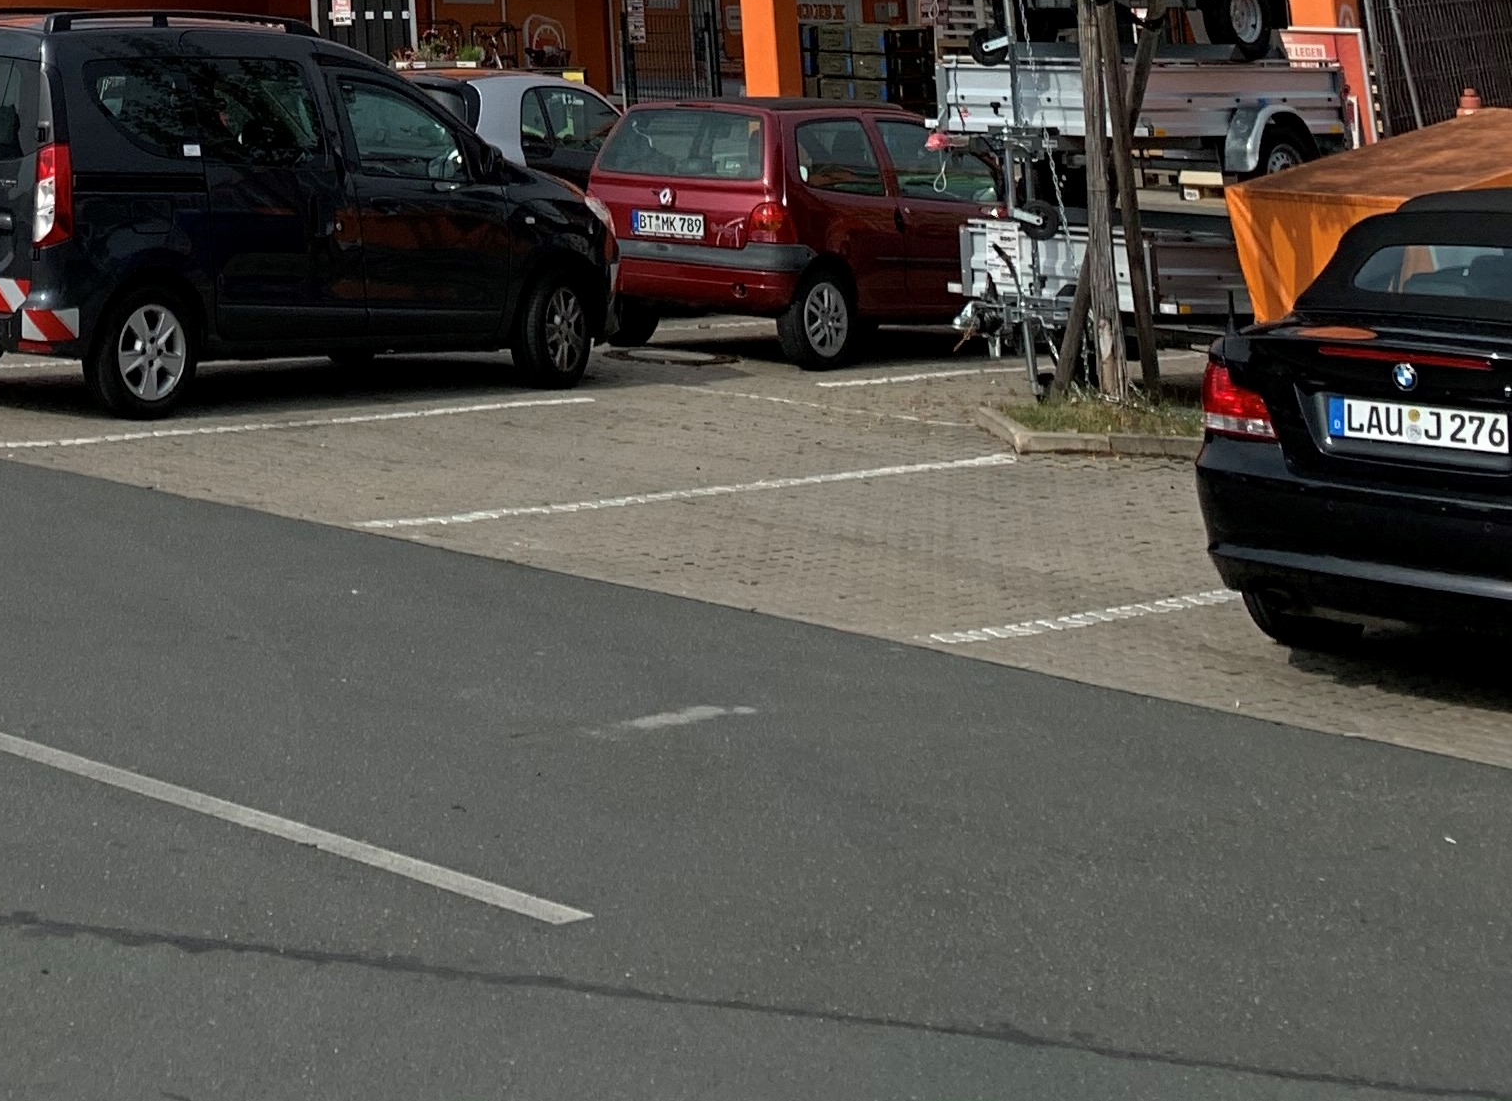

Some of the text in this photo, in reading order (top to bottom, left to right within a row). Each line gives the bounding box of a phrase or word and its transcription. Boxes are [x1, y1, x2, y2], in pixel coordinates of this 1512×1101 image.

[1295, 46, 1323, 58] LEGEN
[639, 214, 702, 234] BT MK 789
[1347, 403, 1506, 448] LAU J 276
